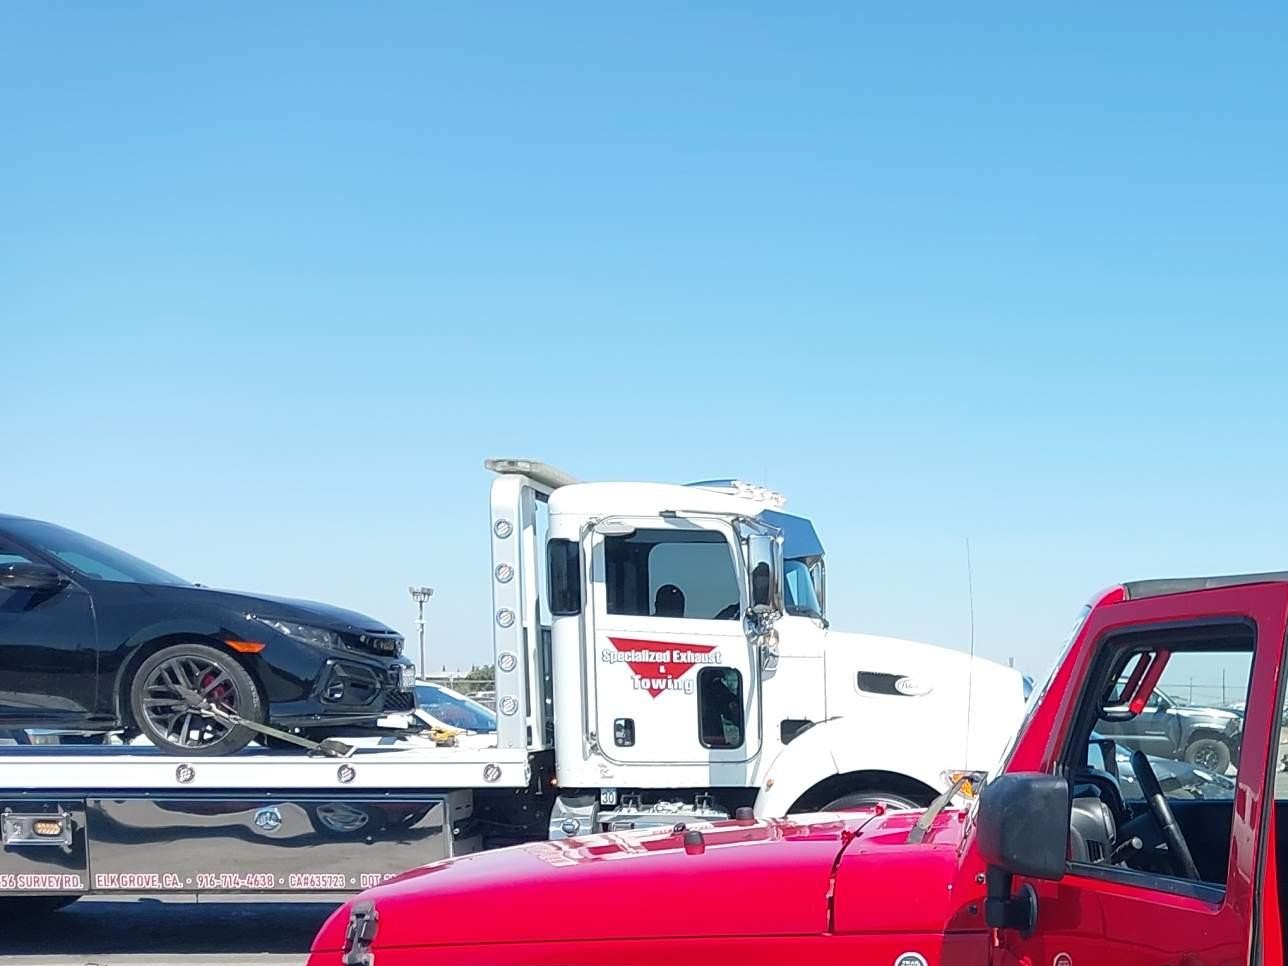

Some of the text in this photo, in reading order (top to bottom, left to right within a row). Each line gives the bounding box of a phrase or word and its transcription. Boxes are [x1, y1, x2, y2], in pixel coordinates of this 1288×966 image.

[601, 648, 722, 664] Specialized Exhaust
[630, 675, 695, 694] Towing
[17, 874, 61, 889] SURVEY
[62, 874, 84, 889] RD.
[95, 873, 120, 889] ELK
[120, 873, 162, 889] GROVE,
[162, 873, 184, 889] CA.
[196, 873, 274, 888] 916-714-4638
[288, 873, 346, 888] CA#635723
[360, 873, 381, 888] DOT
